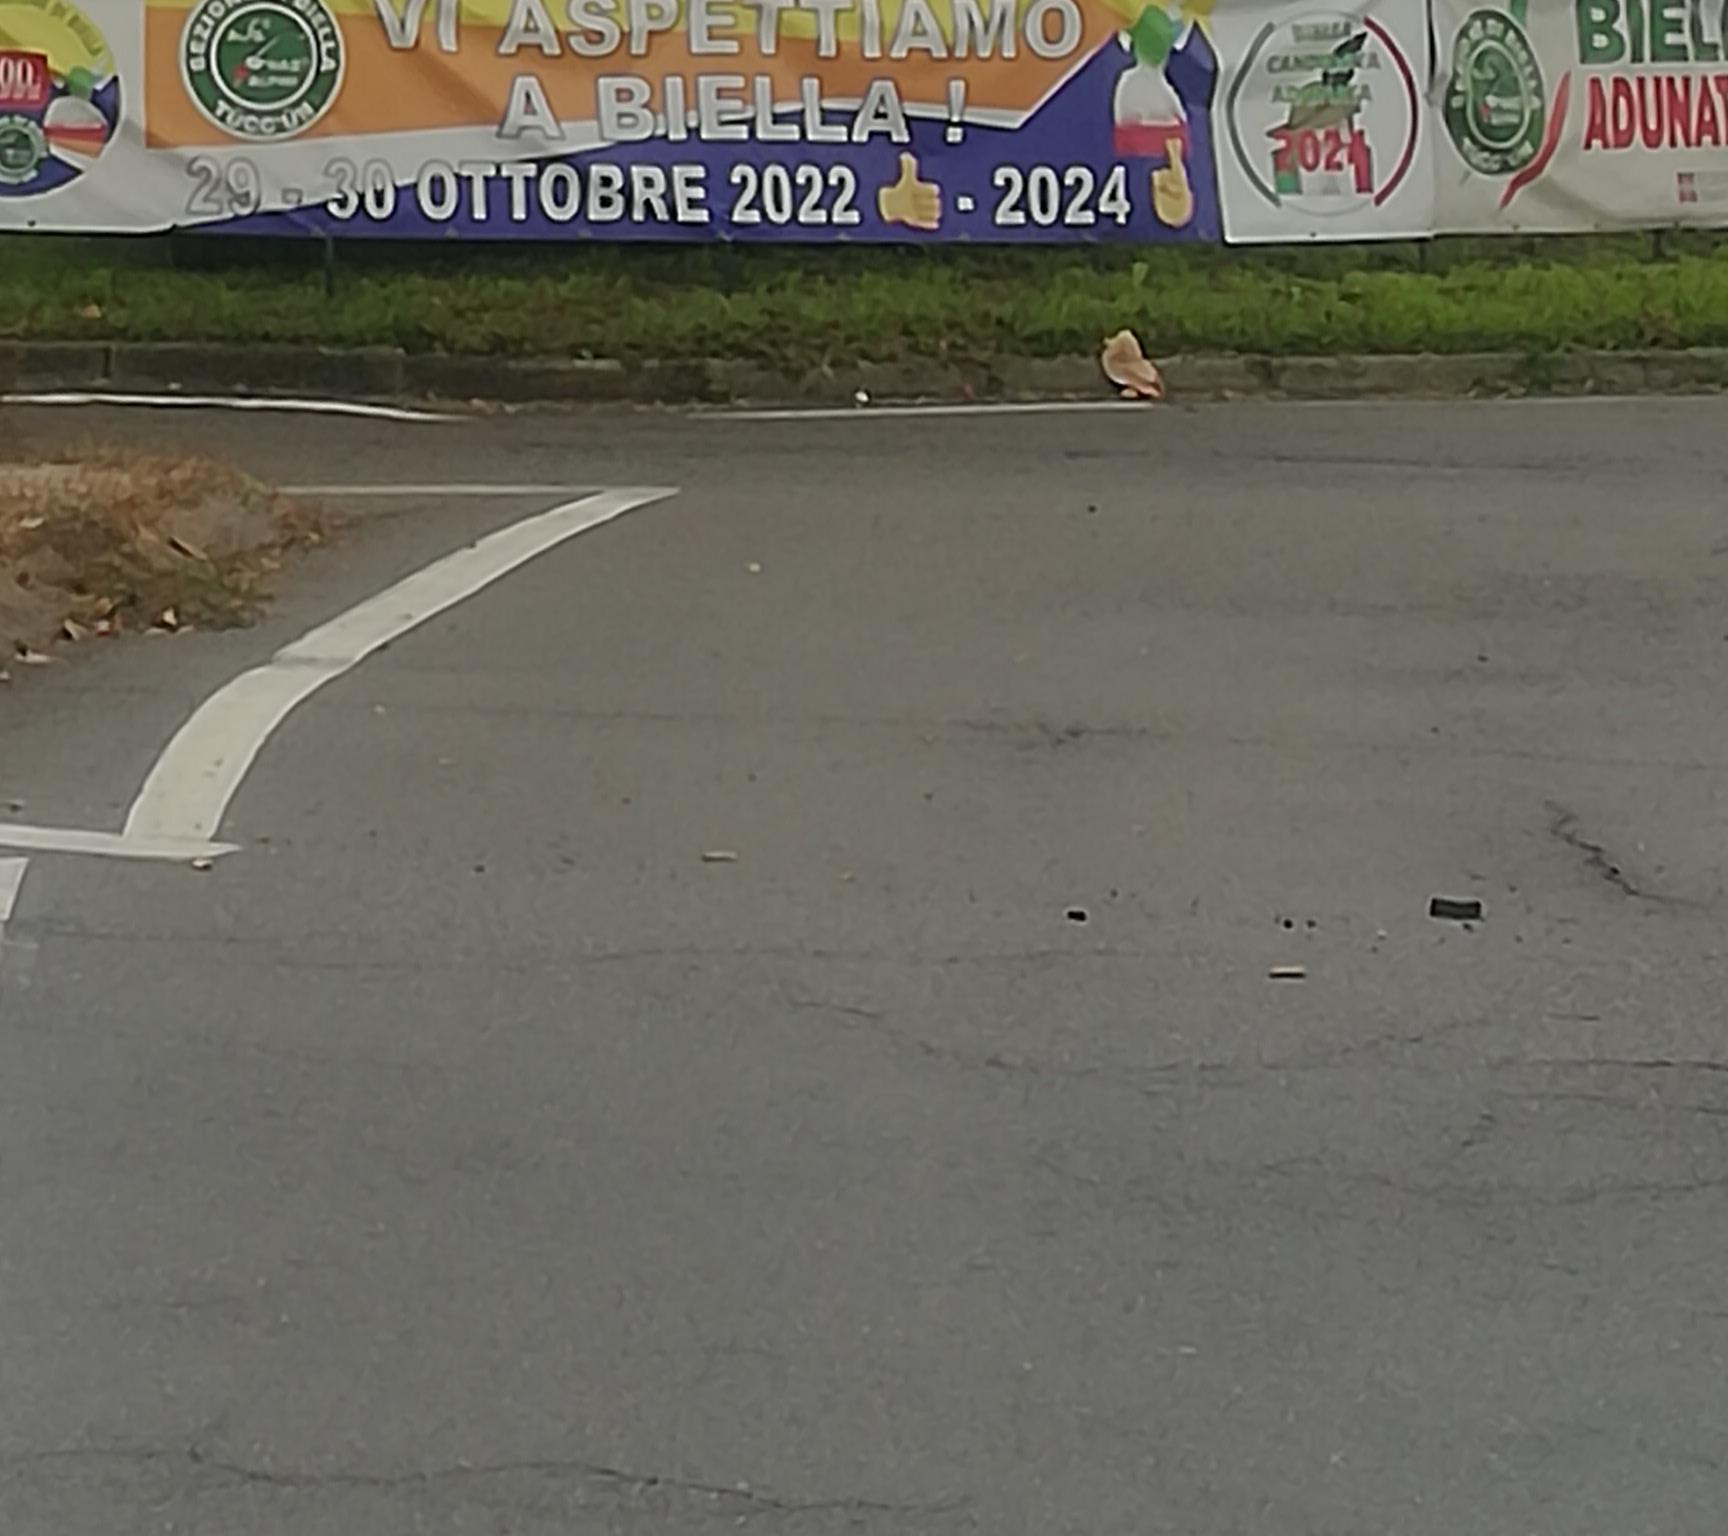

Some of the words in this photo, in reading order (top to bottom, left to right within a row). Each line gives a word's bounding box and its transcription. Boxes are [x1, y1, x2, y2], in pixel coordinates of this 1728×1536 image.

[495, 74, 566, 140] A
[595, 74, 911, 144] BIELLA
[186, 156, 262, 218] 29
[323, 157, 397, 220] 30
[416, 159, 712, 223] OTTOBRE
[729, 164, 862, 225] 2022
[992, 164, 1132, 226] 2024
